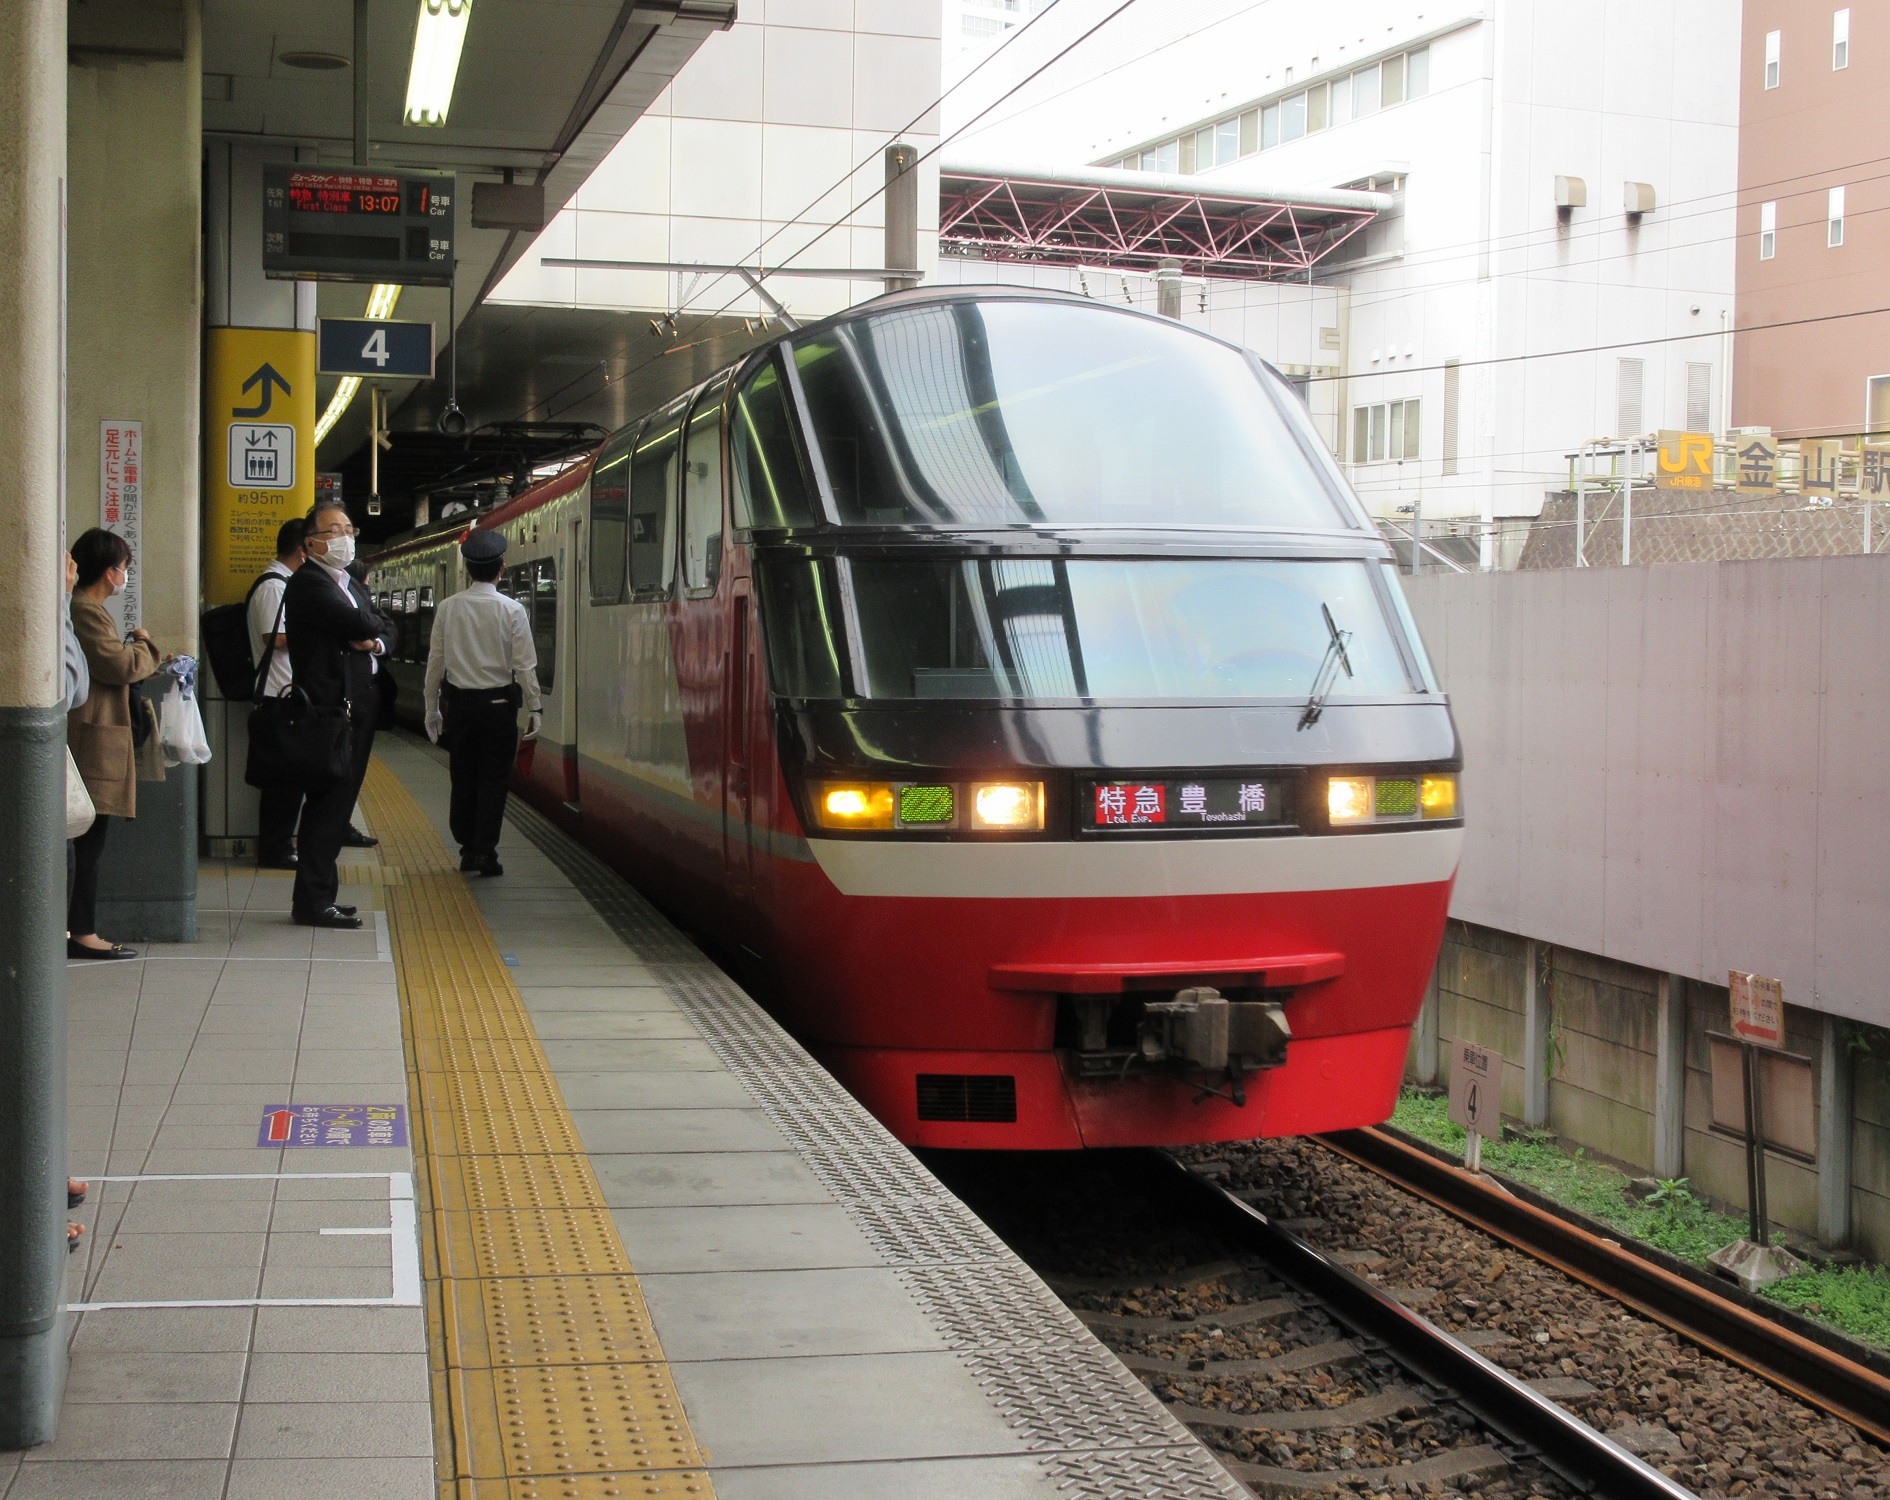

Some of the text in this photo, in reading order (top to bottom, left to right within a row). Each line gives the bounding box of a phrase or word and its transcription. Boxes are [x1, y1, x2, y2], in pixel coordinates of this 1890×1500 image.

[268, 200, 282, 208] 1st
[297, 200, 348, 213] First Class
[359, 195, 399, 212] 13:07
[421, 188, 427, 213] 1
[430, 196, 450, 206] 号車
[430, 207, 446, 216] Car
[266, 244, 284, 253] 2nd
[430, 240, 449, 251] 号車
[429, 251, 445, 260] Car
[361, 329, 390, 367] 4
[1660, 434, 1712, 475] JR
[324, 478, 334, 489] 2
[238, 491, 284, 505] 約95m
[1099, 784, 1266, 815] 特急 豊橋
[1106, 813, 1152, 824] Ltd. Exp.
[1200, 811, 1246, 822] Toyohashi
[300, 1107, 320, 1145] お待ちください
[366, 1106, 397, 1145] 2両の列車は
